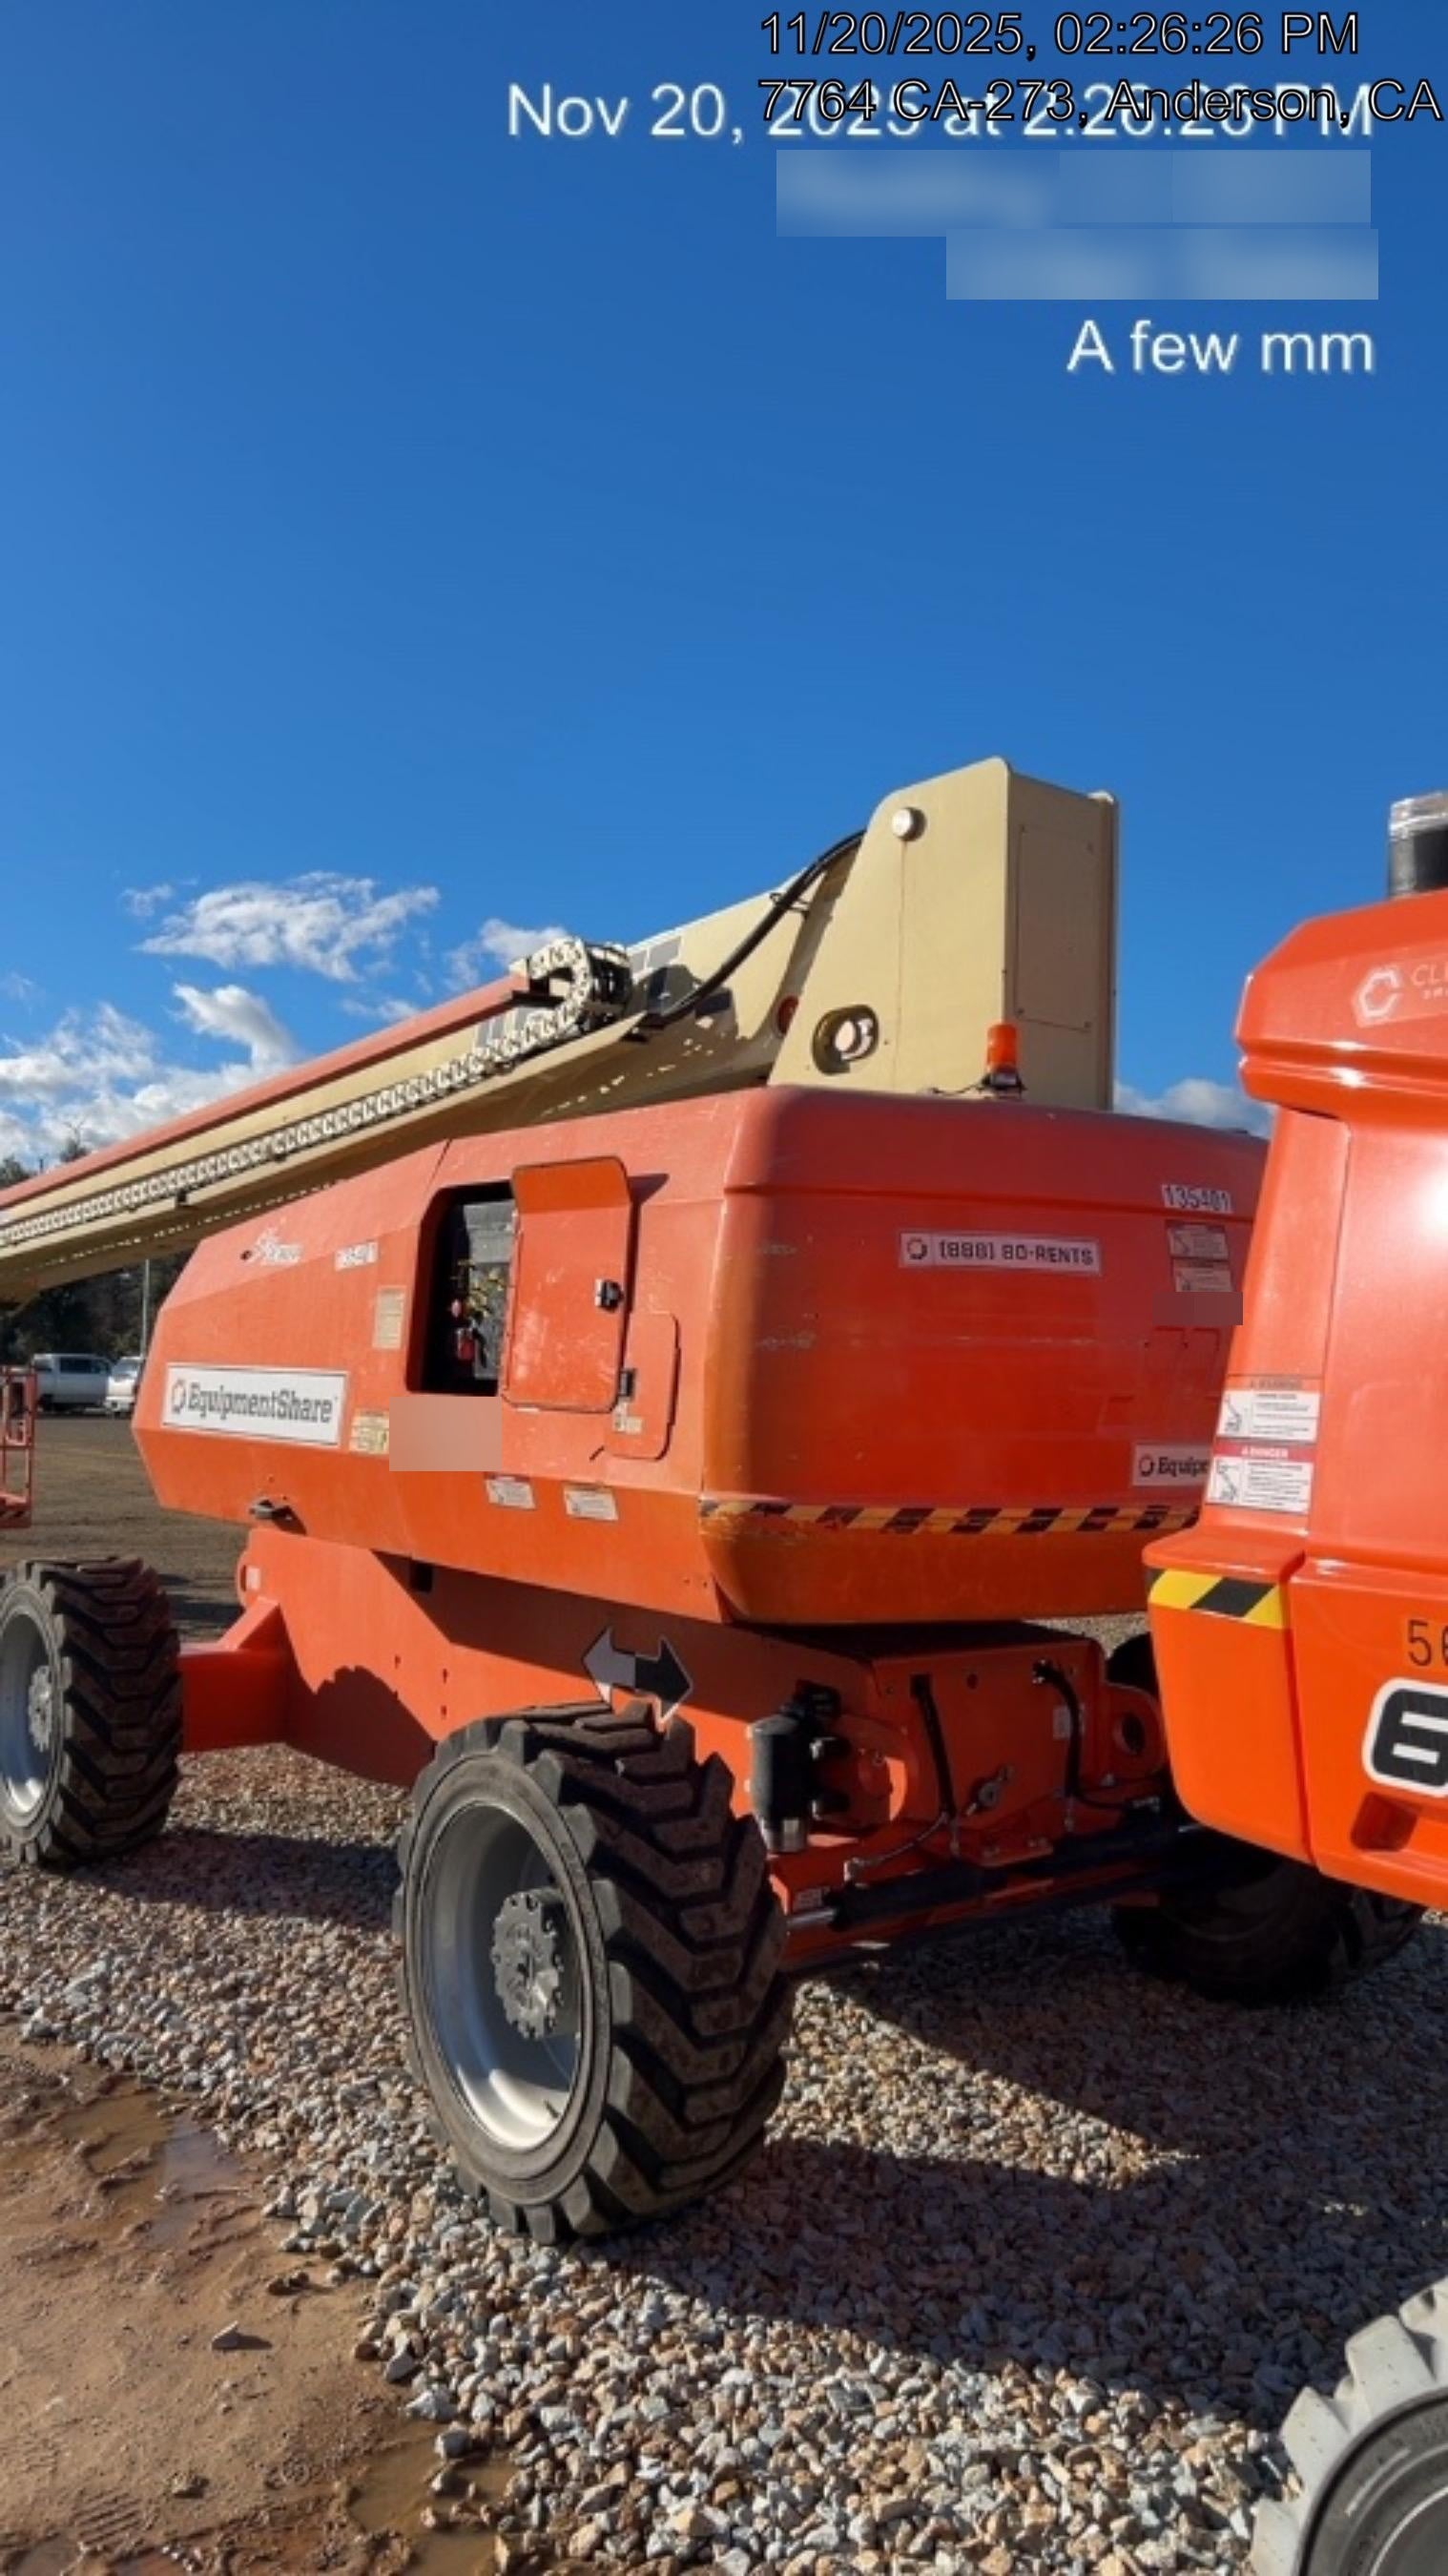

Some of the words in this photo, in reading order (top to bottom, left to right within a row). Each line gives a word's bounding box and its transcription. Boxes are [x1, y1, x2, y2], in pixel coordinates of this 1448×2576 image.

[1412, 960, 1448, 987] CL
[188, 1381, 334, 1423] EquipmentShare
[1158, 1456, 1209, 1478] Equip
